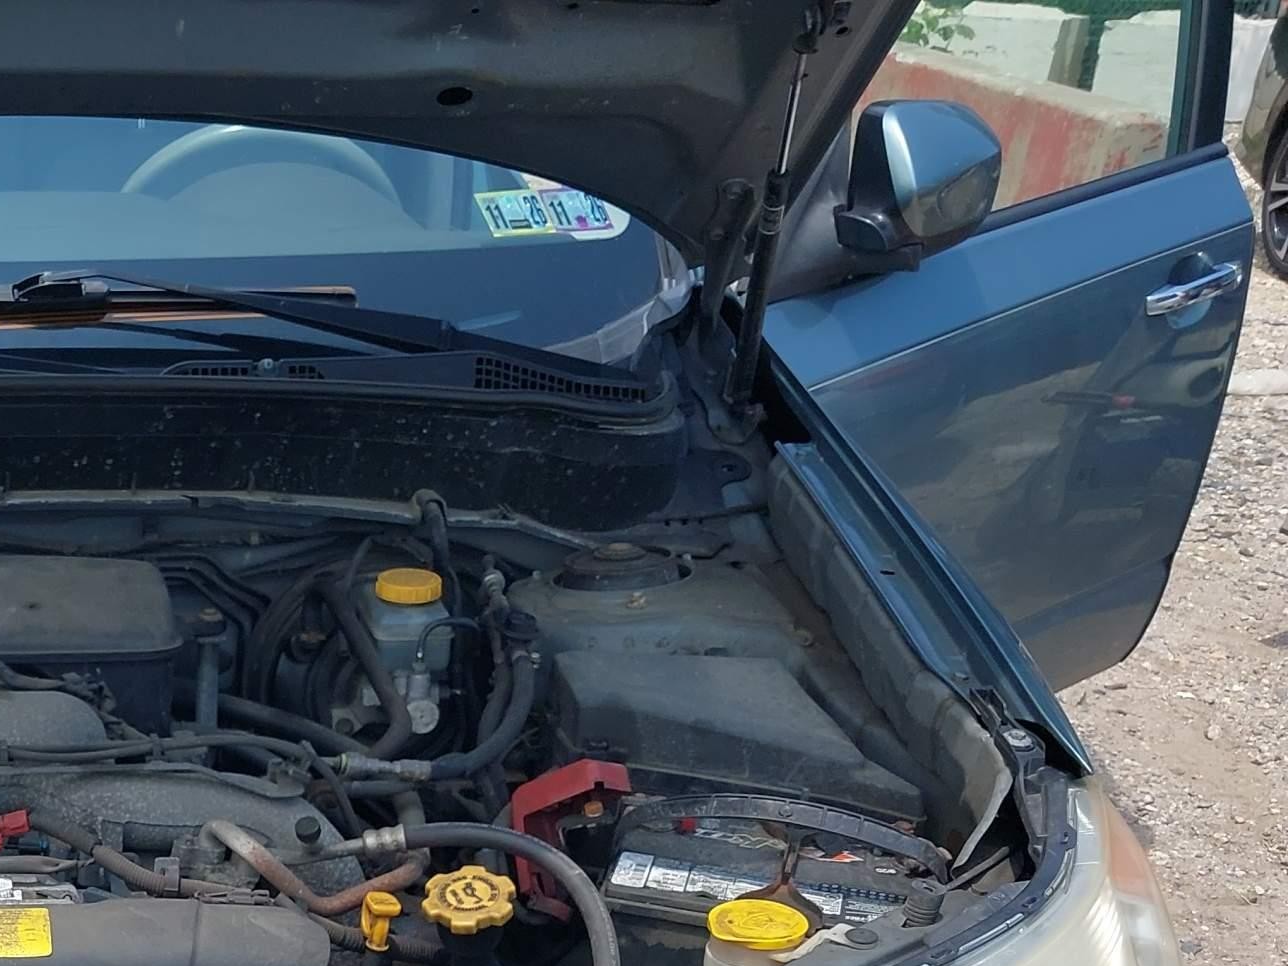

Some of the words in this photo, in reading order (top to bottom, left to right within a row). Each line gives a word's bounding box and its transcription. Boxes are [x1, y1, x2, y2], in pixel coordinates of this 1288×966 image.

[485, 203, 509, 230] 11
[523, 195, 548, 227] 26
[548, 200, 572, 226] 11
